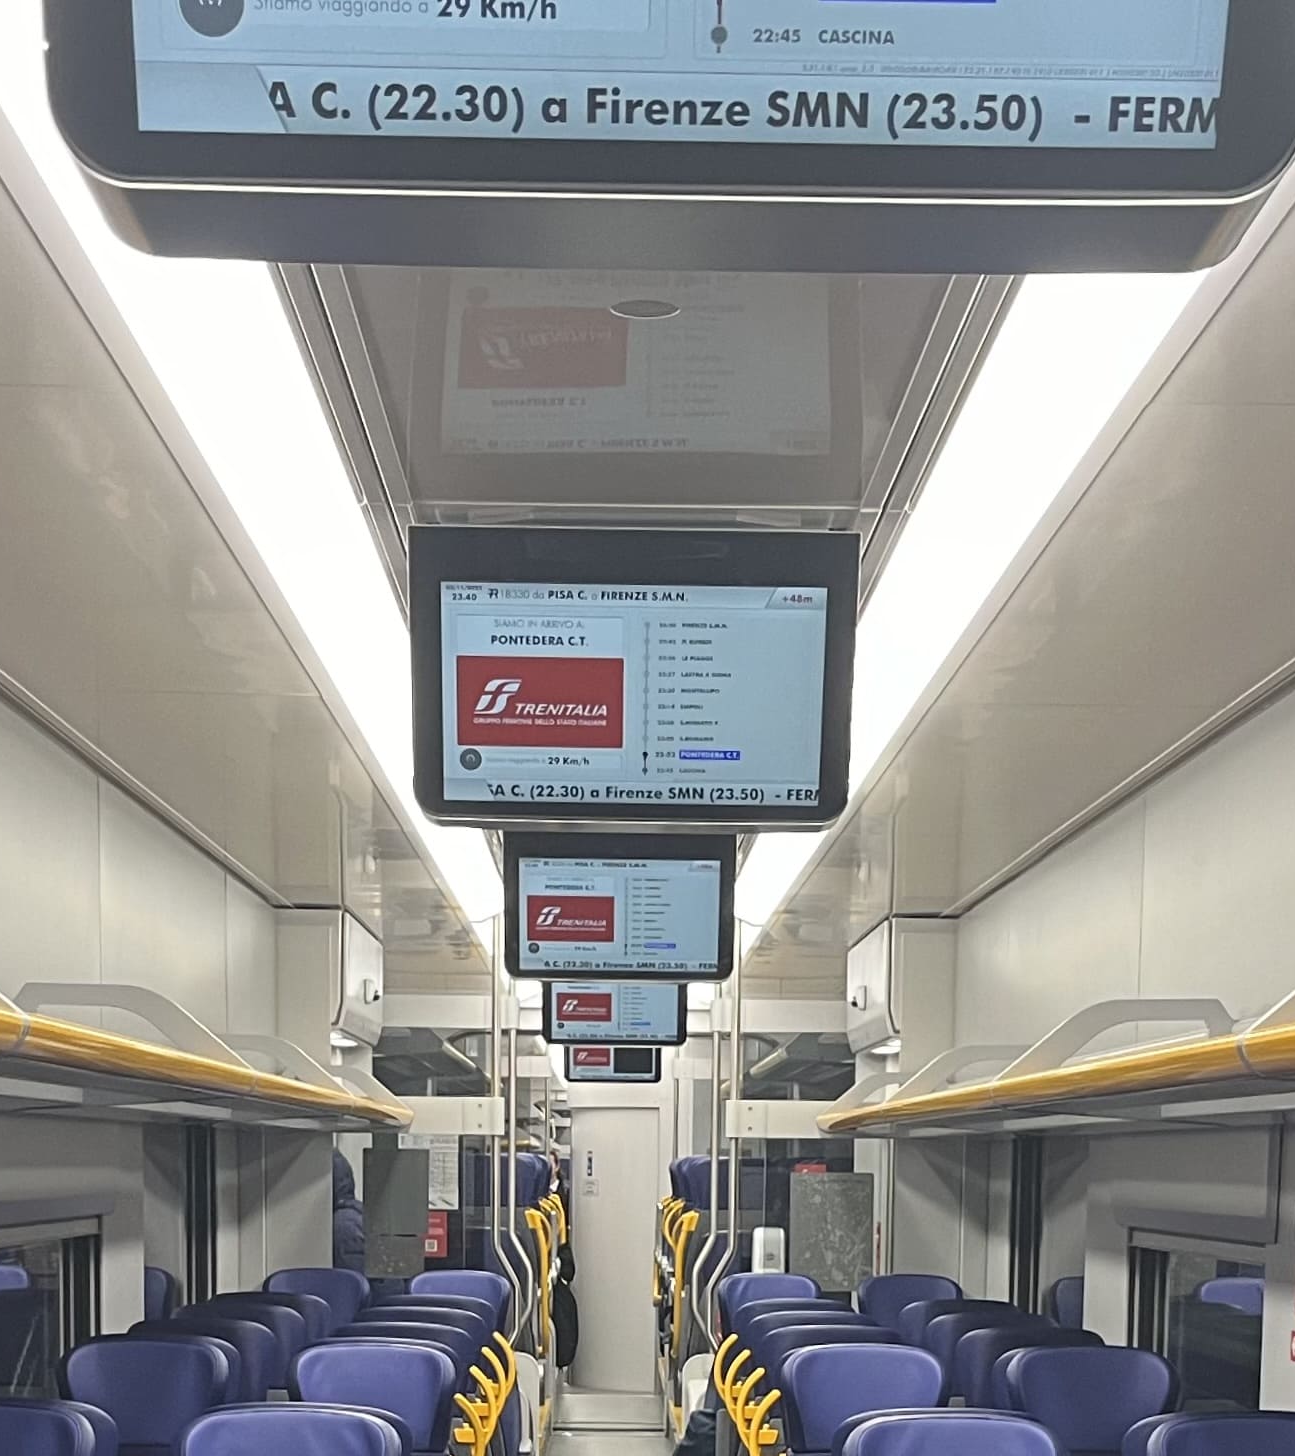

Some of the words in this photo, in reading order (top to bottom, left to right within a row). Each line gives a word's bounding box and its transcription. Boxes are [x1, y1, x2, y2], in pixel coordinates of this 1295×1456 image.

[418, 3, 428, 13] a
[437, 0, 470, 18] 29
[480, 0, 557, 22] Km/h
[753, 29, 801, 43] 22:45
[818, 29, 895, 45] CASCINA
[312, 81, 351, 119] C.
[368, 84, 524, 133] (22.30)
[541, 97, 567, 123] a
[587, 87, 750, 126] Firenze
[766, 90, 869, 128] SMN
[887, 93, 1042, 142] (23.50)
[532, 590, 545, 600] da
[548, 590, 574, 600] PISA
[577, 590, 588, 600] C.
[601, 591, 648, 601] FIRENZE
[651, 591, 689, 602] S.M.N.
[491, 635, 564, 646] PONTEDERA
[568, 636, 590, 647] C.T.
[514, 703, 608, 717] TRENITALIA
[547, 756, 560, 766] 29
[562, 756, 590, 767] Km/h
[510, 784, 524, 798] C.
[530, 785, 585, 801] (22.30)
[590, 789, 600, 798] a
[606, 785, 663, 800] Firenze
[668, 787, 705, 800] SMN
[709, 787, 764, 803] (23.50)
